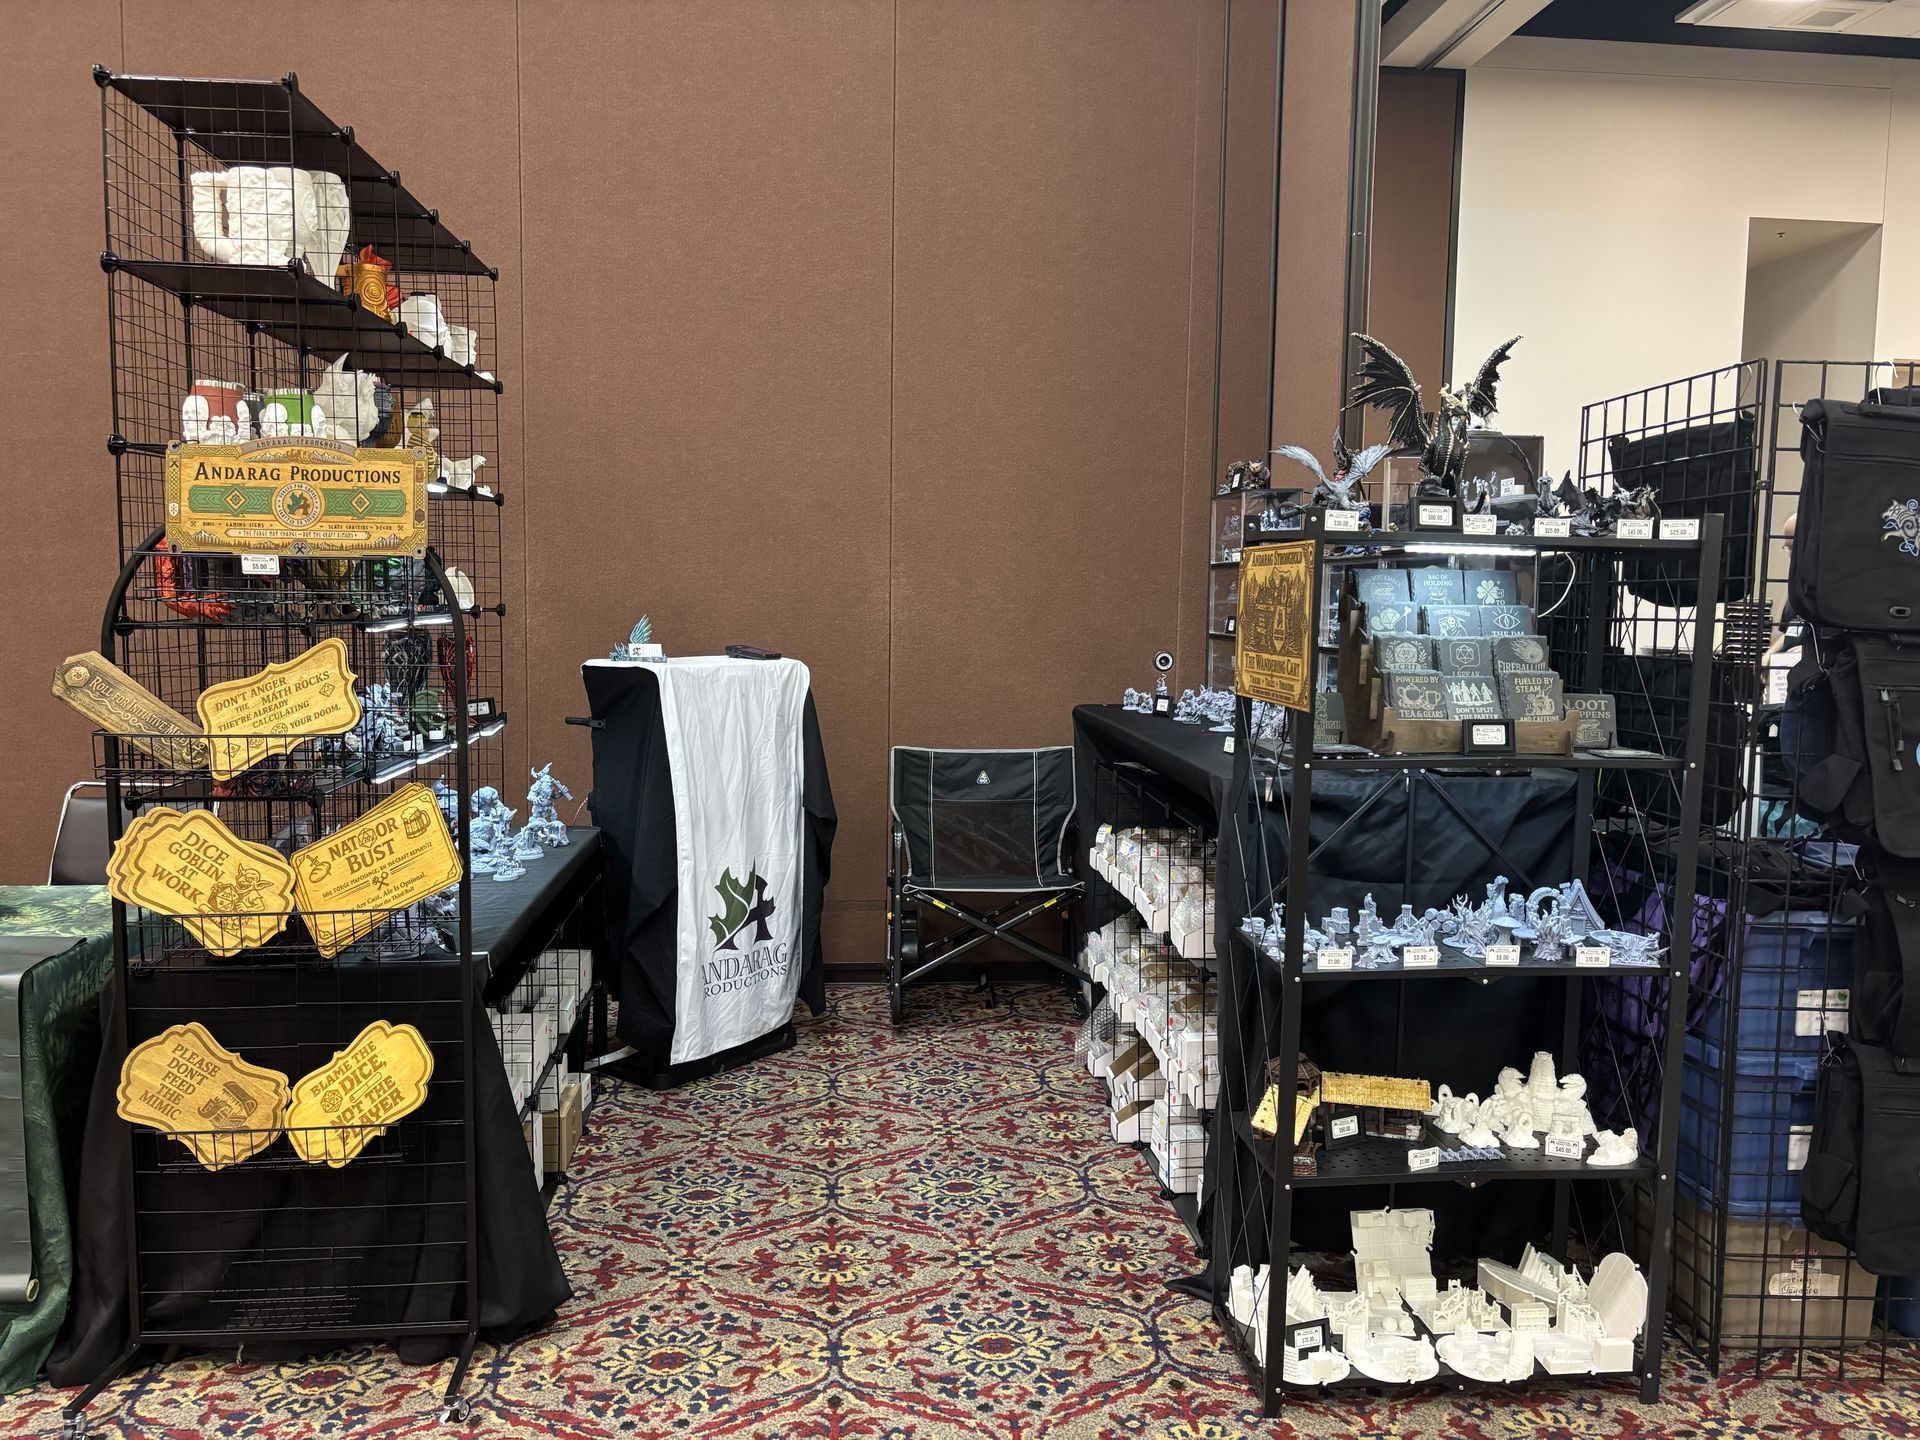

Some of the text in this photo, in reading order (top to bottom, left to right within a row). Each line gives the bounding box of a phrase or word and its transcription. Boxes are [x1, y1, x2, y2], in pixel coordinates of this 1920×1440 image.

[194, 461, 401, 484] ANDARAG PRODUCTIONS
[1544, 527, 1560, 535] $25.00
[89, 675, 114, 697] ROLL
[112, 693, 130, 709] FOR
[214, 676, 287, 712] DON'T ANGER
[235, 670, 330, 714] THE MATH ROCKS
[1514, 677, 1542, 685] FUELED
[1515, 685, 1541, 693] STEAM
[217, 698, 289, 733] THEY'RE ALREADY
[252, 700, 310, 729] CALCULATING
[289, 703, 342, 729] YOUR DOOM.
[1400, 710, 1444, 718] TEA & GEARS
[1564, 699, 1608, 711] LOOT
[1580, 710, 1611, 719] PPENS
[182, 830, 230, 866] DICE
[328, 835, 358, 862] NAT
[375, 817, 400, 838] OR
[168, 841, 226, 882] GOBLIN
[176, 864, 199, 881] AT
[345, 838, 395, 875] BUST
[395, 851, 410, 865] CRAFT
[152, 863, 205, 905] WORK
[383, 888, 393, 897] Ale
[704, 964, 788, 999] RODUCTIONS
[166, 1056, 209, 1086] DON'T
[171, 1042, 221, 1078] PLEASE
[310, 1040, 377, 1098] BLAME THE
[338, 1053, 387, 1096] DICE,
[156, 1082, 185, 1106] THE
[161, 1070, 197, 1096] FEED
[138, 1089, 182, 1121] MIMIC
[330, 1074, 397, 1133] NOT THE
[337, 1087, 406, 1147] PLAYER
